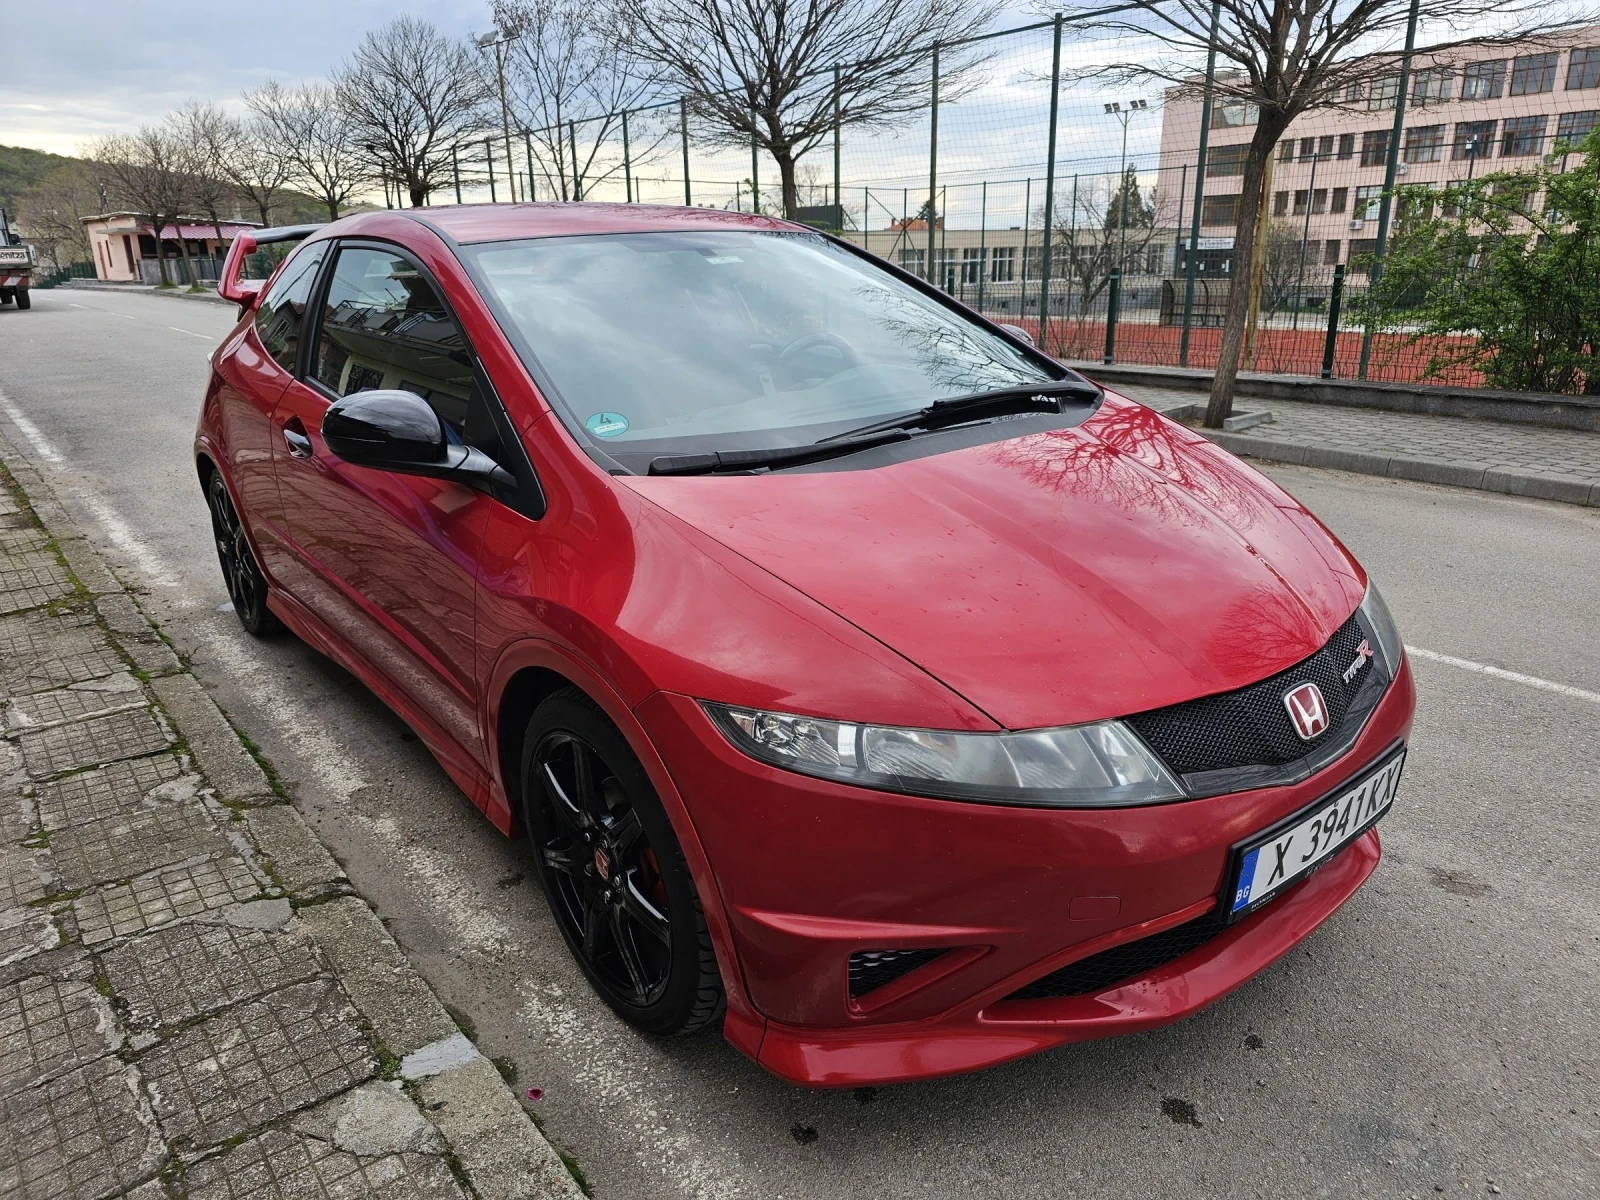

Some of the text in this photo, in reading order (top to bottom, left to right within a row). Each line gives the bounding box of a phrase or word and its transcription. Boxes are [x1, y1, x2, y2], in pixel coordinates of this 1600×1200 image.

[1356, 639, 1374, 661] R
[1267, 834, 1294, 887] X
[1235, 885, 1250, 903] BG
